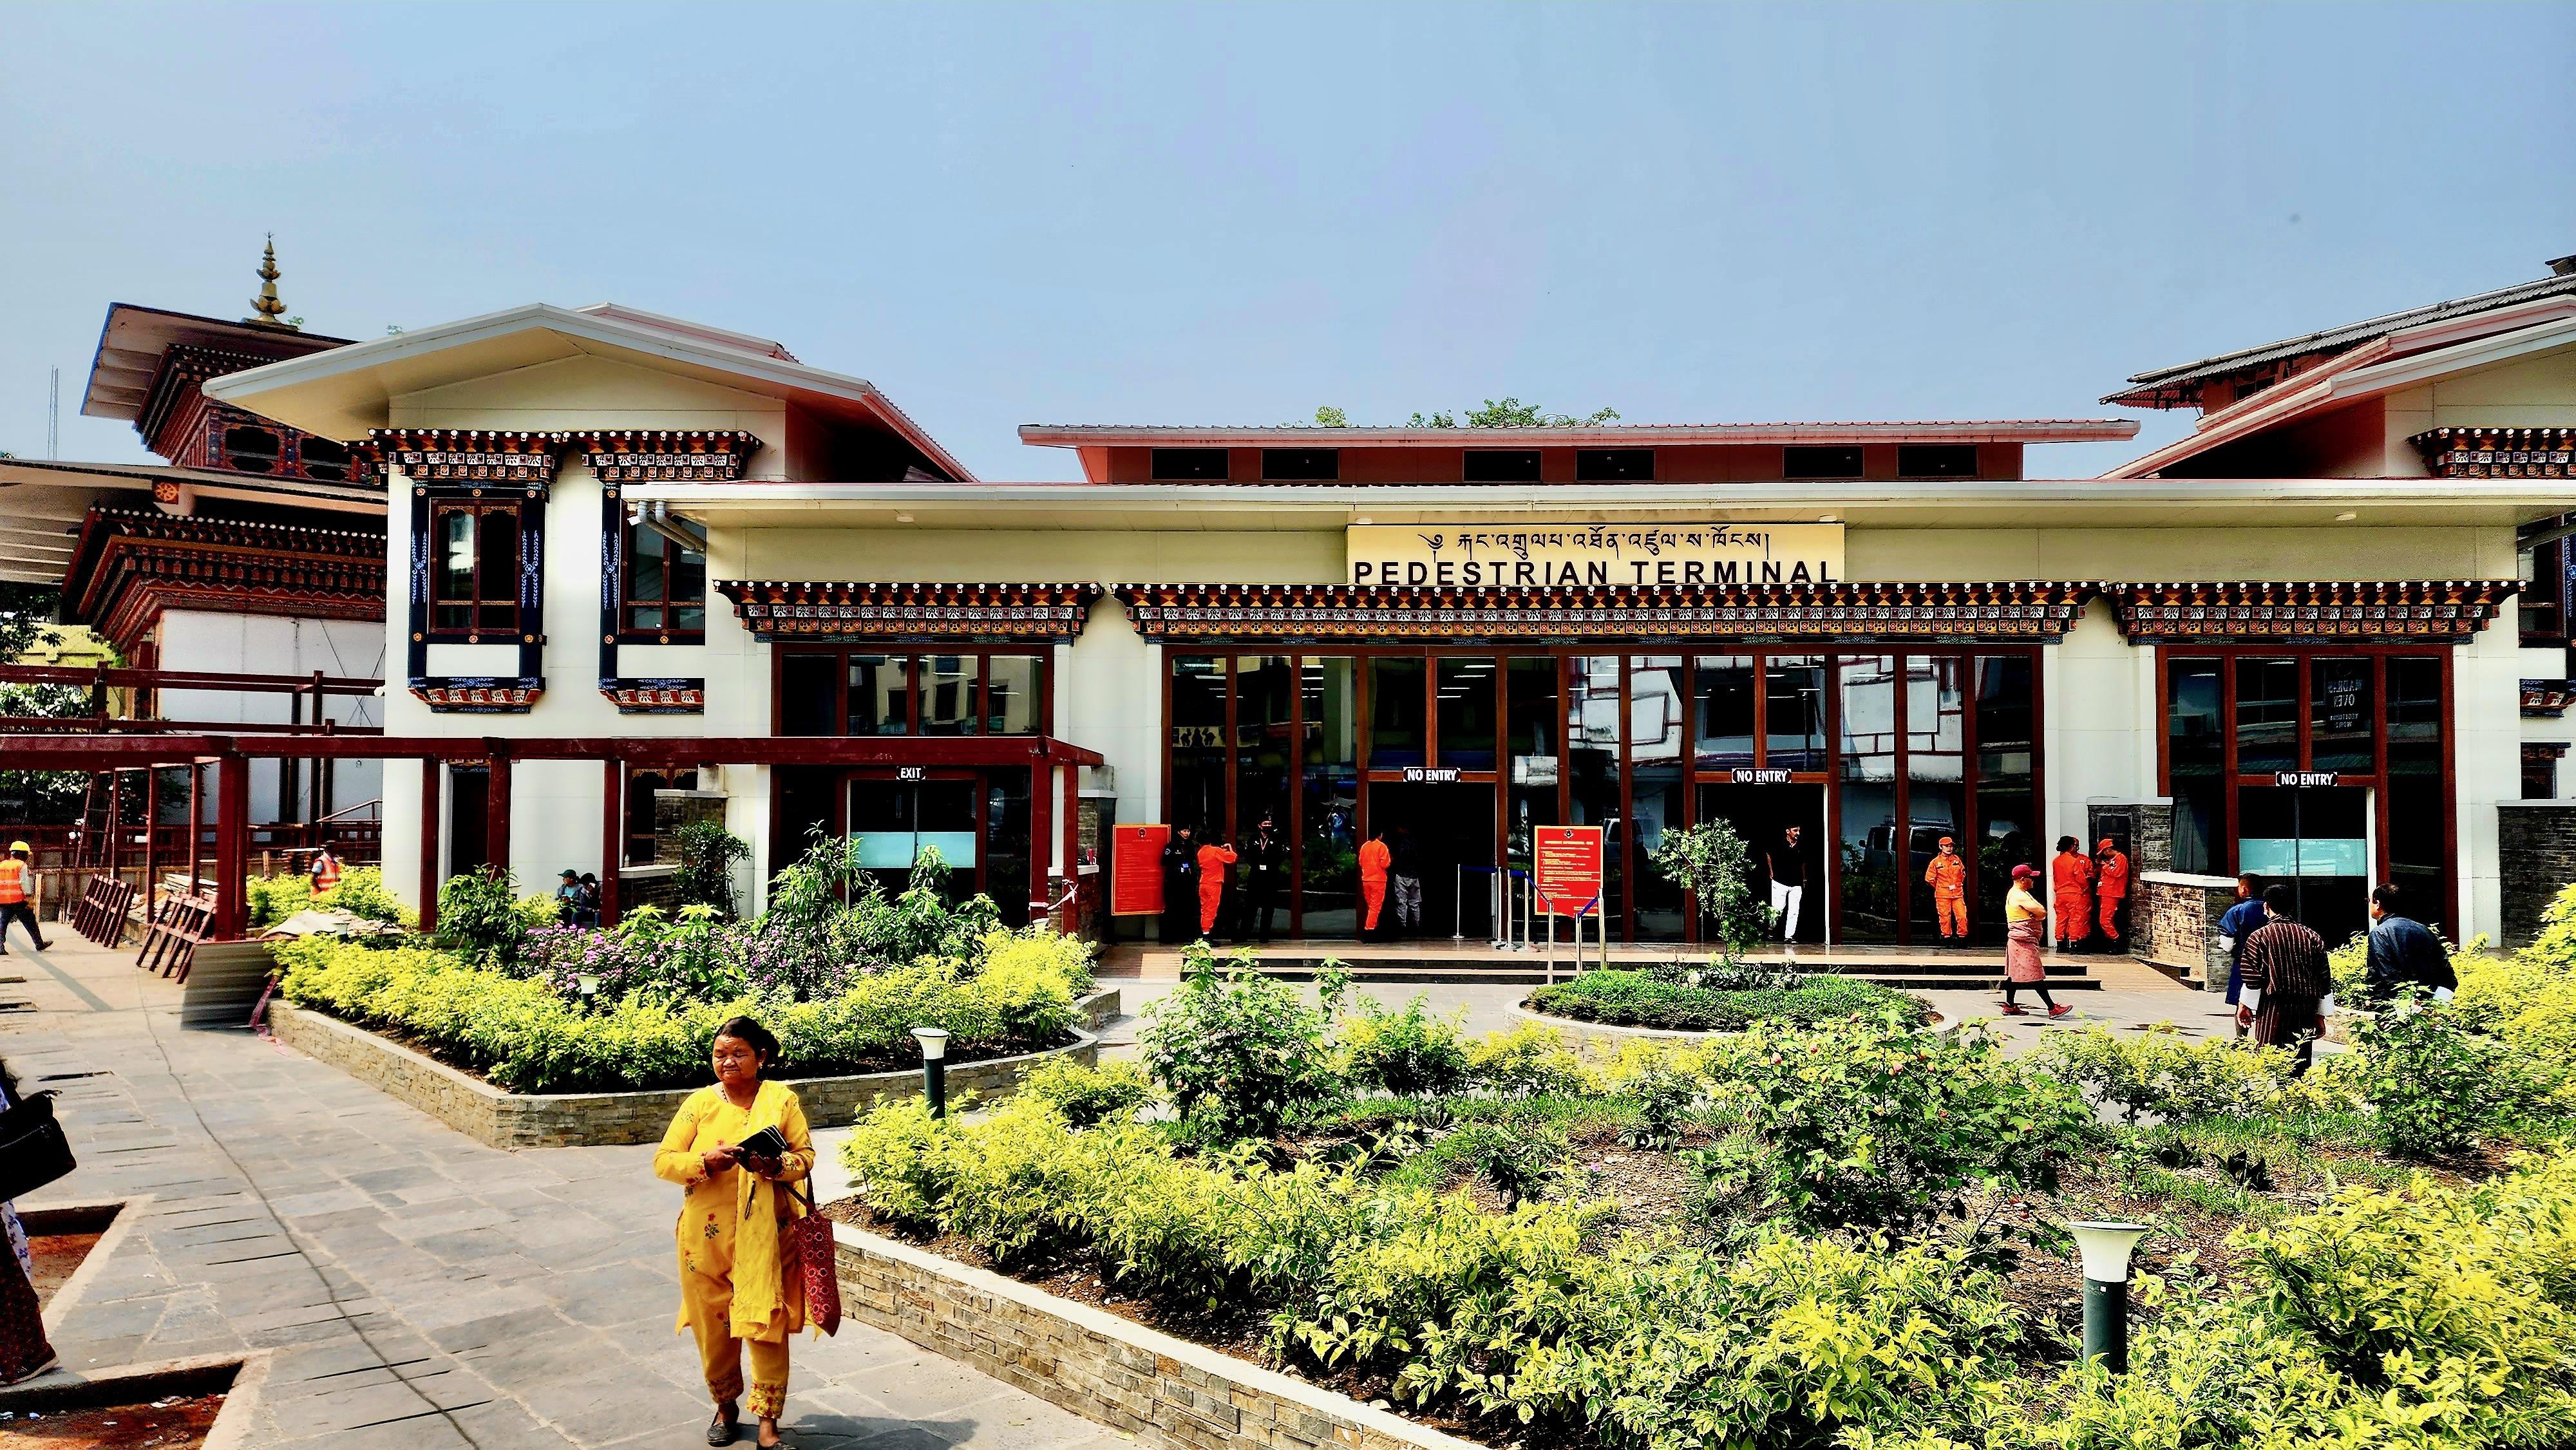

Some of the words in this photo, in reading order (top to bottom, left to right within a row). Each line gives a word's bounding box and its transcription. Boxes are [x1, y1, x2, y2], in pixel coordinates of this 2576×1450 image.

[1354, 561, 1607, 585] PEDESTRIAN
[1630, 561, 1838, 585] TERMINAL
[900, 767, 922, 778] EXIT
[1407, 769, 1423, 781] NO
[1426, 769, 1457, 781] ENTRY
[1736, 770, 1753, 782] NO
[1756, 770, 1788, 782] ENTRY
[2281, 773, 2298, 786] NO
[2300, 773, 2334, 786] ENTRY
